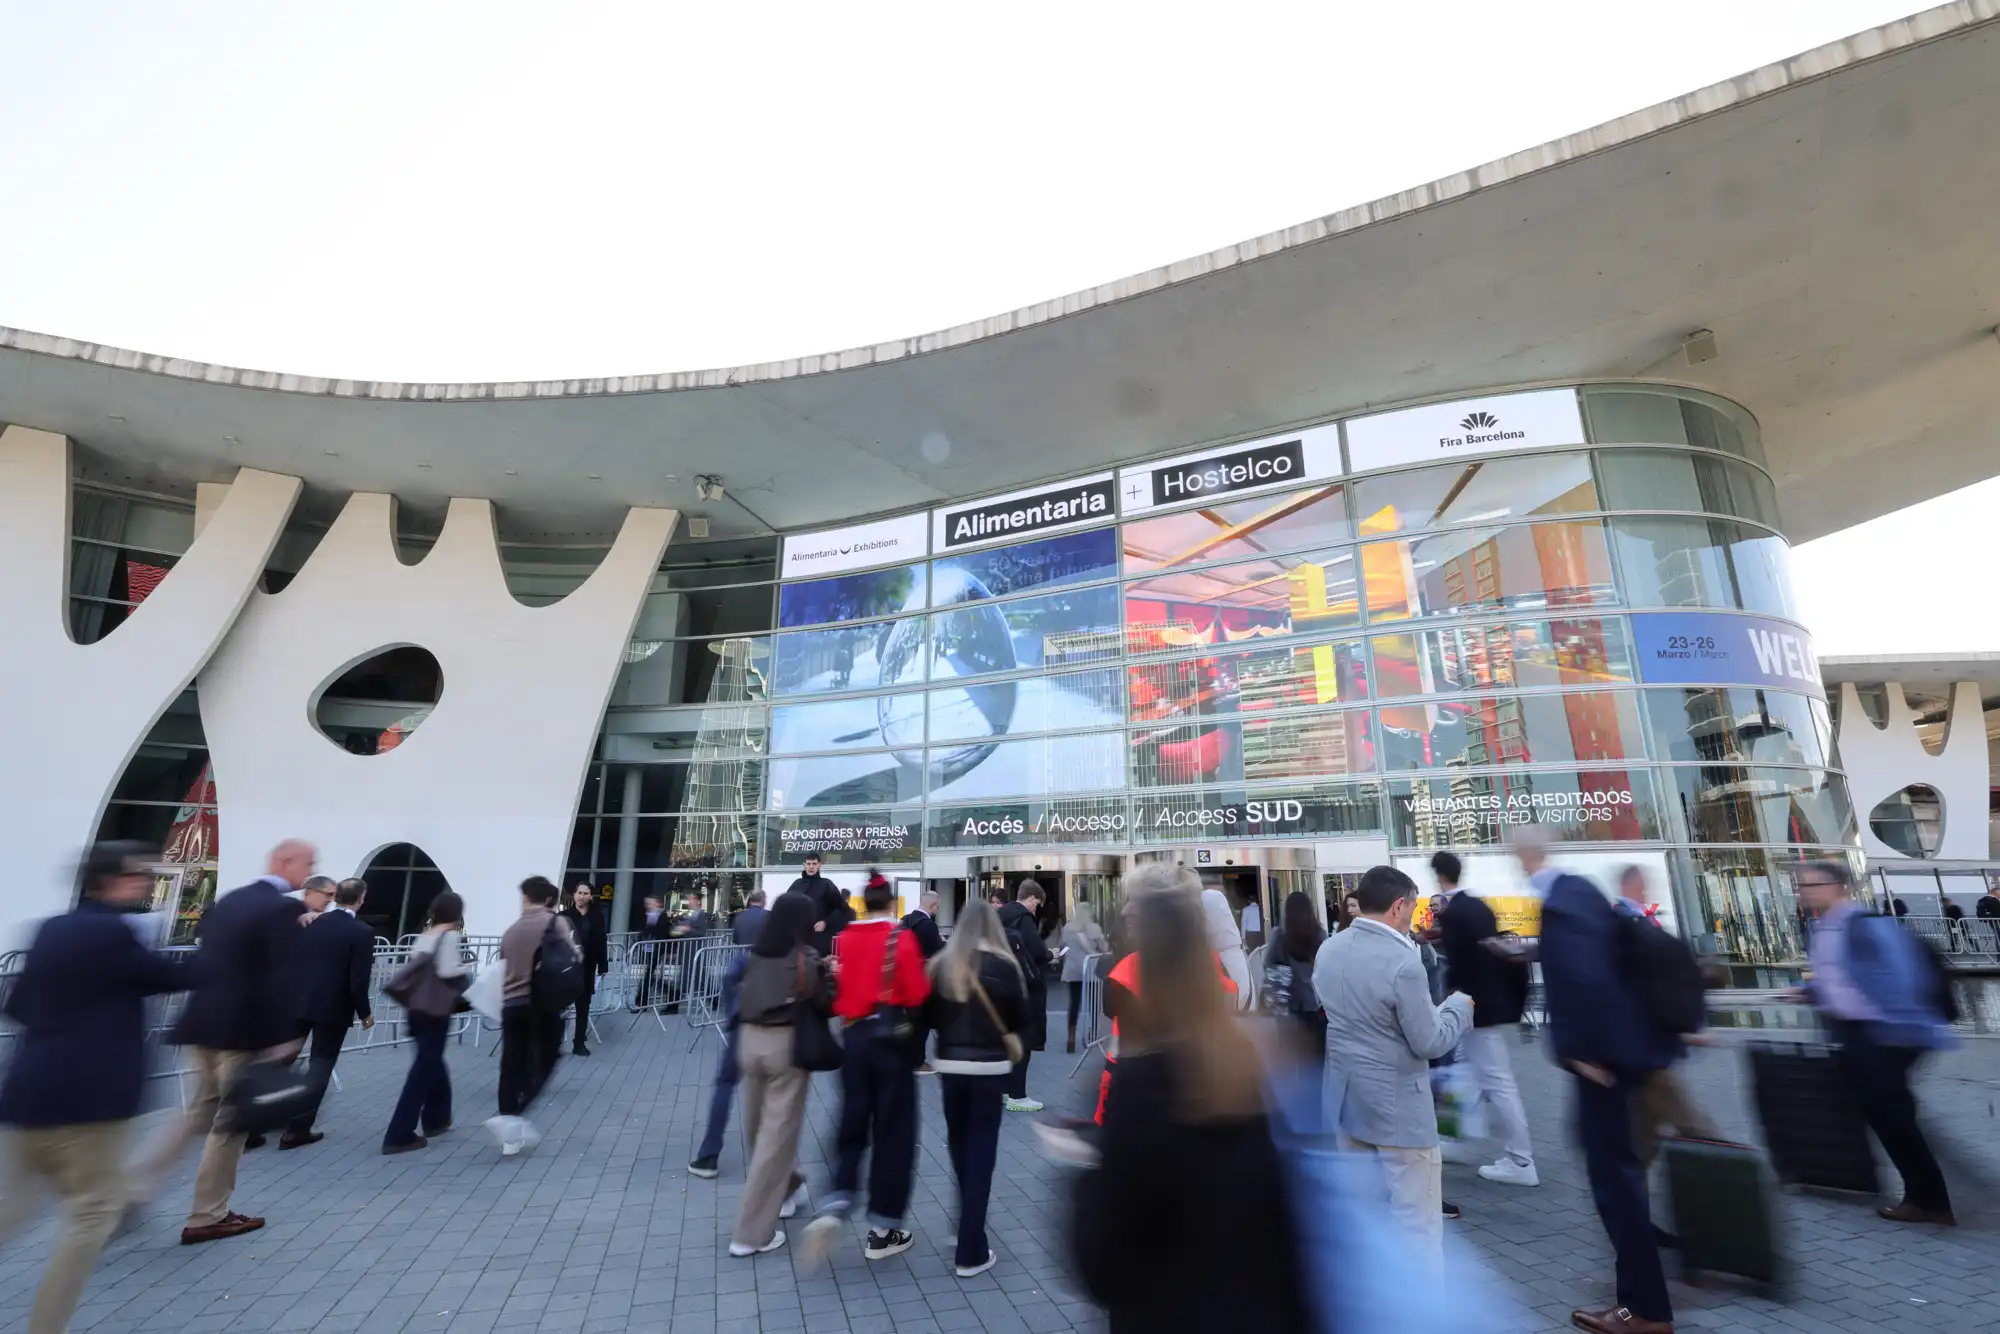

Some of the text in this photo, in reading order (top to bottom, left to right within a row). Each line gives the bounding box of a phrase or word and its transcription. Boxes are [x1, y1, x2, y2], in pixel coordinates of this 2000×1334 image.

[1440, 430, 1525, 448] Fira Barcelona
[1164, 455, 1292, 496] Hostelco
[954, 491, 1106, 540] Alimentaria
[791, 538, 899, 562] Alimentaria Exhibitions
[1668, 636, 1715, 649] 23-26
[1657, 650, 1691, 659] Marzo
[1404, 790, 1633, 812] VISITANTES ACREDITADOS
[963, 816, 1023, 836] Accés
[1049, 812, 1125, 833] Acceso
[1155, 806, 1238, 828] Access
[1245, 799, 1303, 824] SUD
[1428, 807, 1613, 827] REGISTERED VISITORS
[781, 825, 909, 840] EXPOSITORES Y PRENSA
[784, 837, 903, 852] EXHIBITORS AND PRESS
